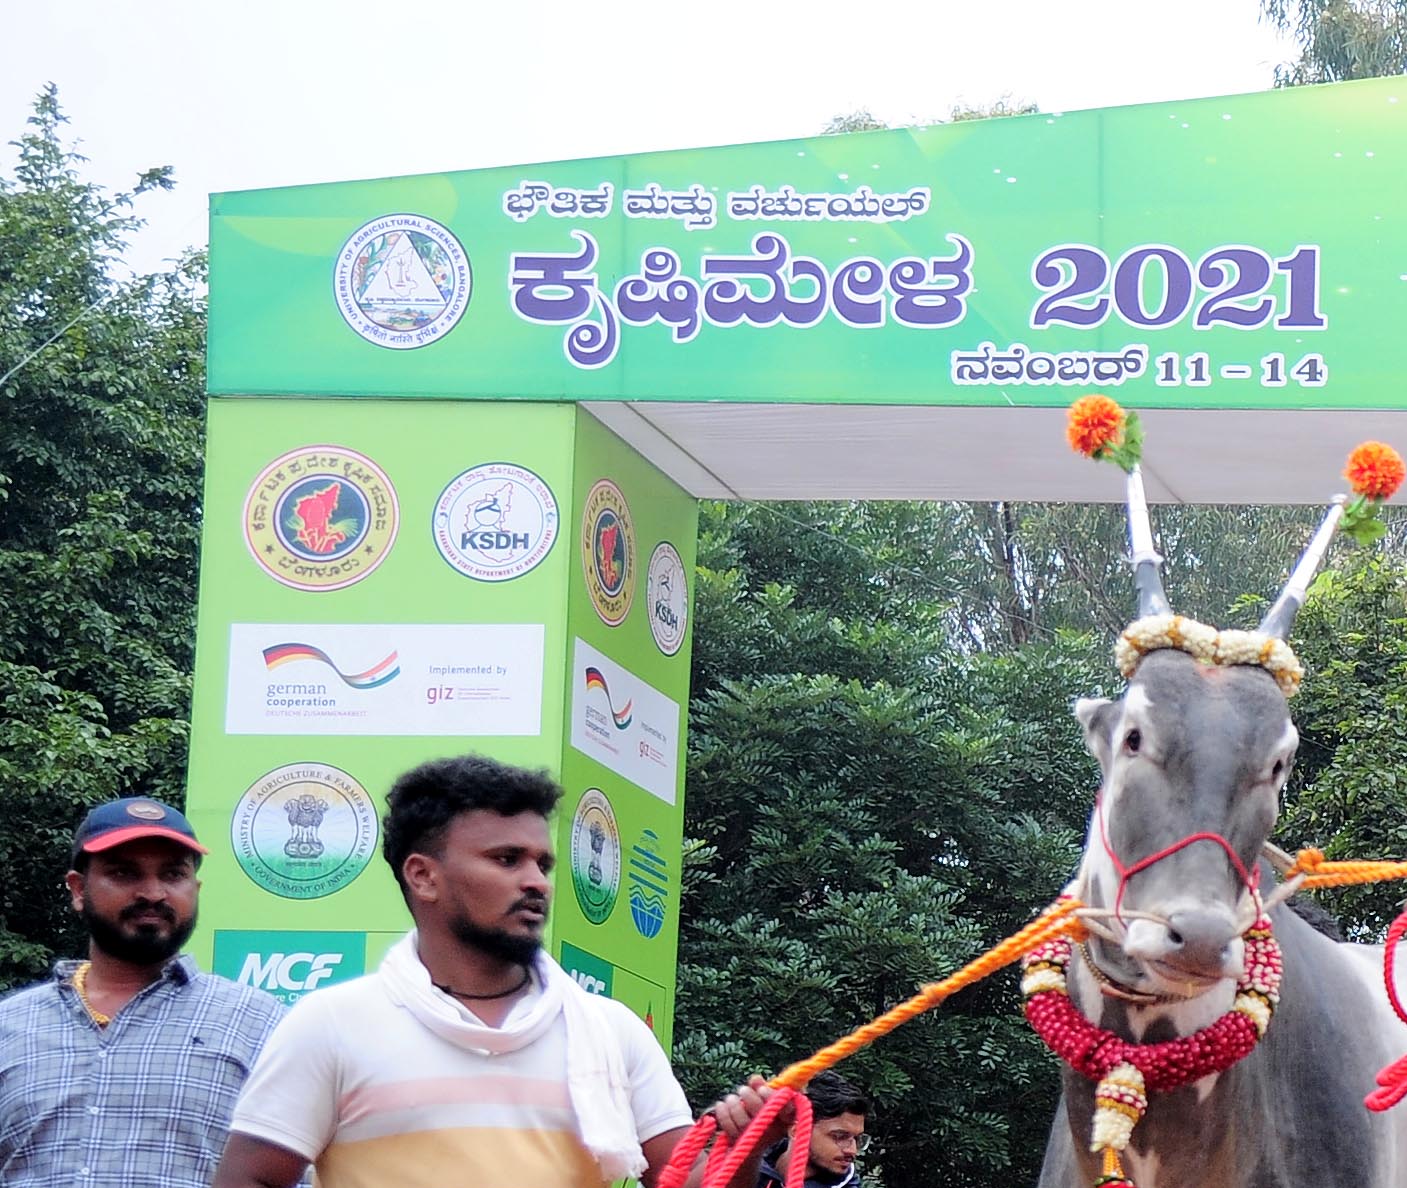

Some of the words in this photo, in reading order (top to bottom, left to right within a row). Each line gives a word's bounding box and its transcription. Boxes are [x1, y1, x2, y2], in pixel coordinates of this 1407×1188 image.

[507, 184, 610, 218] ಭೌತಿಕ
[626, 186, 713, 226] ಮತ್ತು
[731, 187, 926, 218] ವರ್ಚುಯಲ್
[353, 219, 422, 246] AGRICULTURAL
[344, 249, 356, 260] OF
[340, 263, 358, 321] UNIVERSITY
[444, 265, 466, 321] BANGALORE
[512, 230, 974, 366] ಕೃಷಿಮೇಳ
[1033, 247, 1324, 328] 2021
[954, 346, 1142, 384] ನವೆಂಬರ್
[461, 532, 529, 550] KSDH
[429, 665, 492, 677] Implemented
[496, 665, 507, 677] by
[266, 696, 336, 708] cooperation
[267, 684, 327, 699] german
[427, 685, 454, 705] giz
[240, 812, 253, 859] MINISTRY
[247, 797, 258, 811] OF
[256, 770, 323, 800] AGRICULTURE
[324, 774, 333, 782] &
[334, 777, 368, 815] FARMERS
[355, 814, 371, 860] WELFARE
[254, 865, 315, 894] GOVERNMENT
[314, 883, 326, 892] OF
[327, 868, 352, 888] INDIA
[236, 952, 344, 991] MCF
